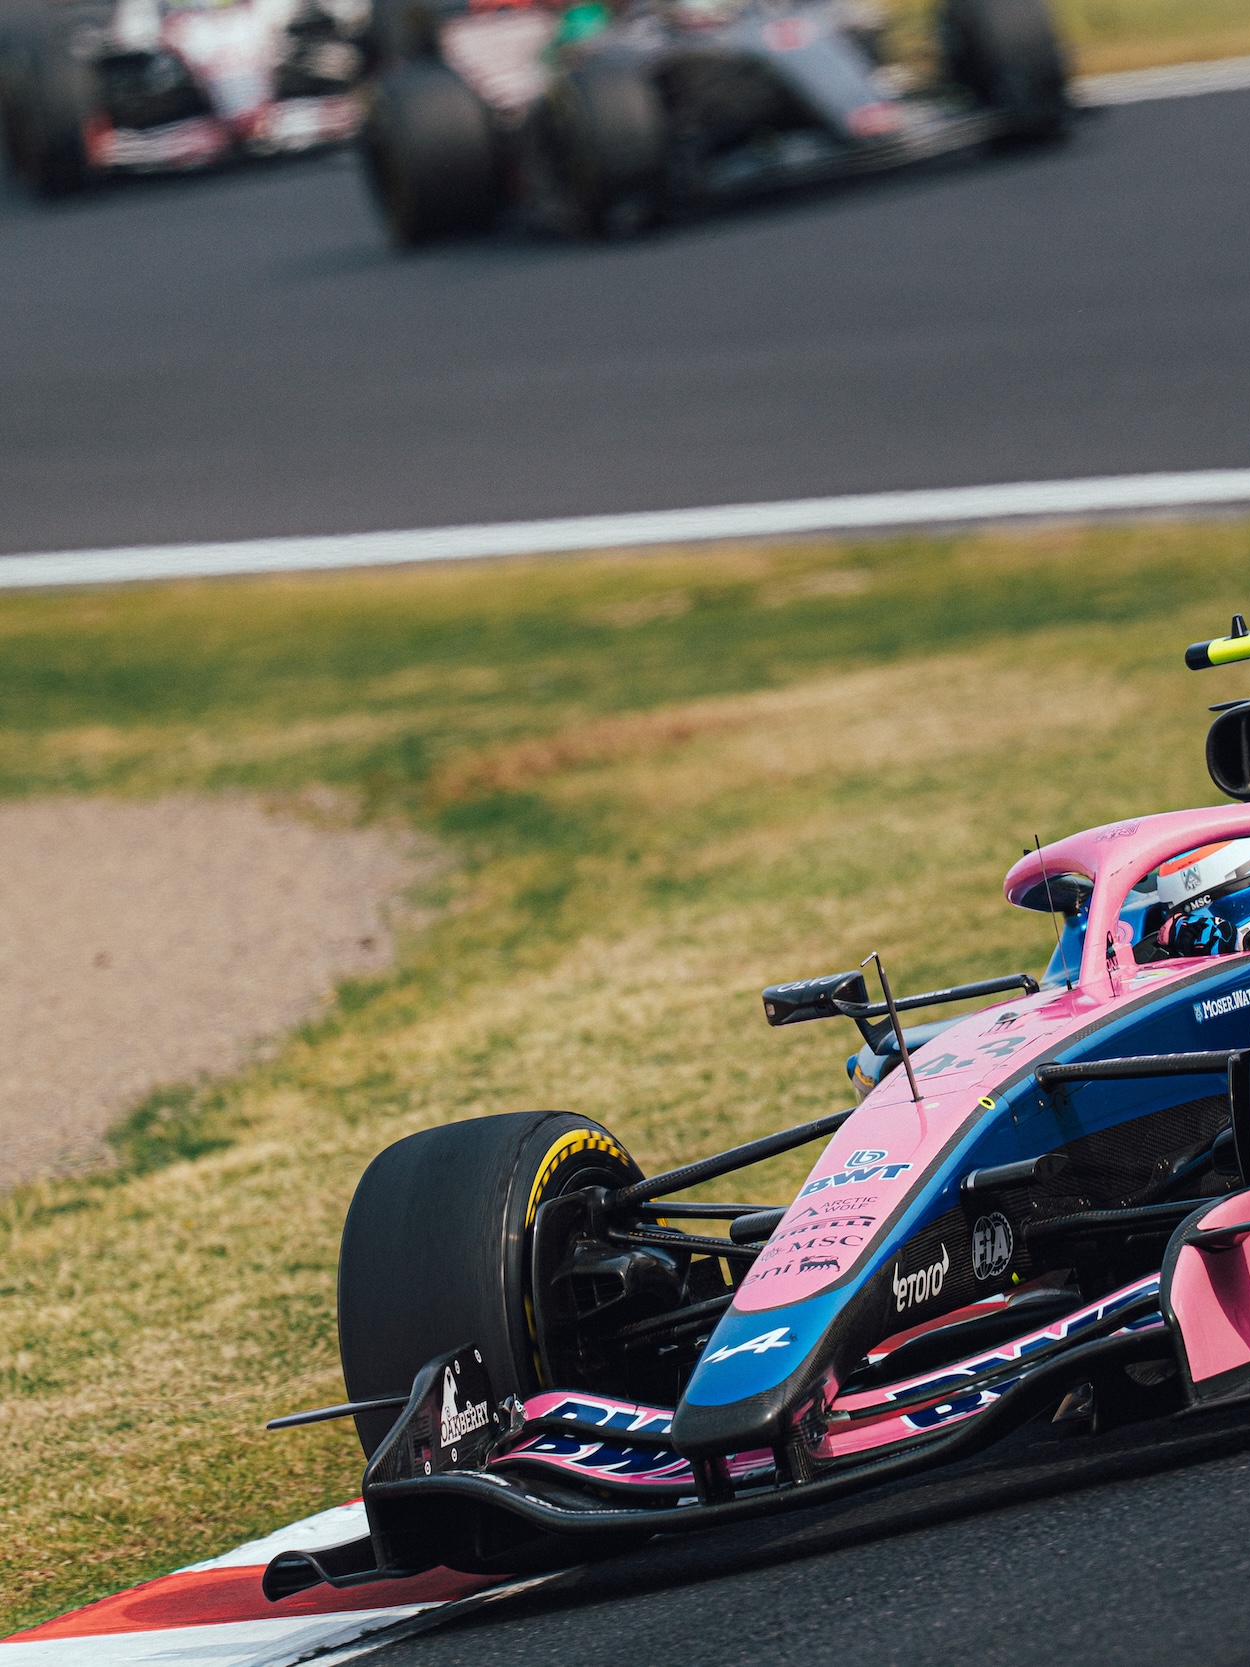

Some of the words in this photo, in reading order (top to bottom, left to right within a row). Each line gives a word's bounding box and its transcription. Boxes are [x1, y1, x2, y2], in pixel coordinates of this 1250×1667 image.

[1190, 894, 1212, 910] MSC
[799, 1163, 913, 1199] BWT
[820, 1196, 878, 1209] ARCTIC
[825, 1203, 869, 1213] WOLF
[787, 1235, 864, 1254] MSC
[742, 1260, 795, 1287] eni
[441, 1401, 489, 1442] OAKBERRY
